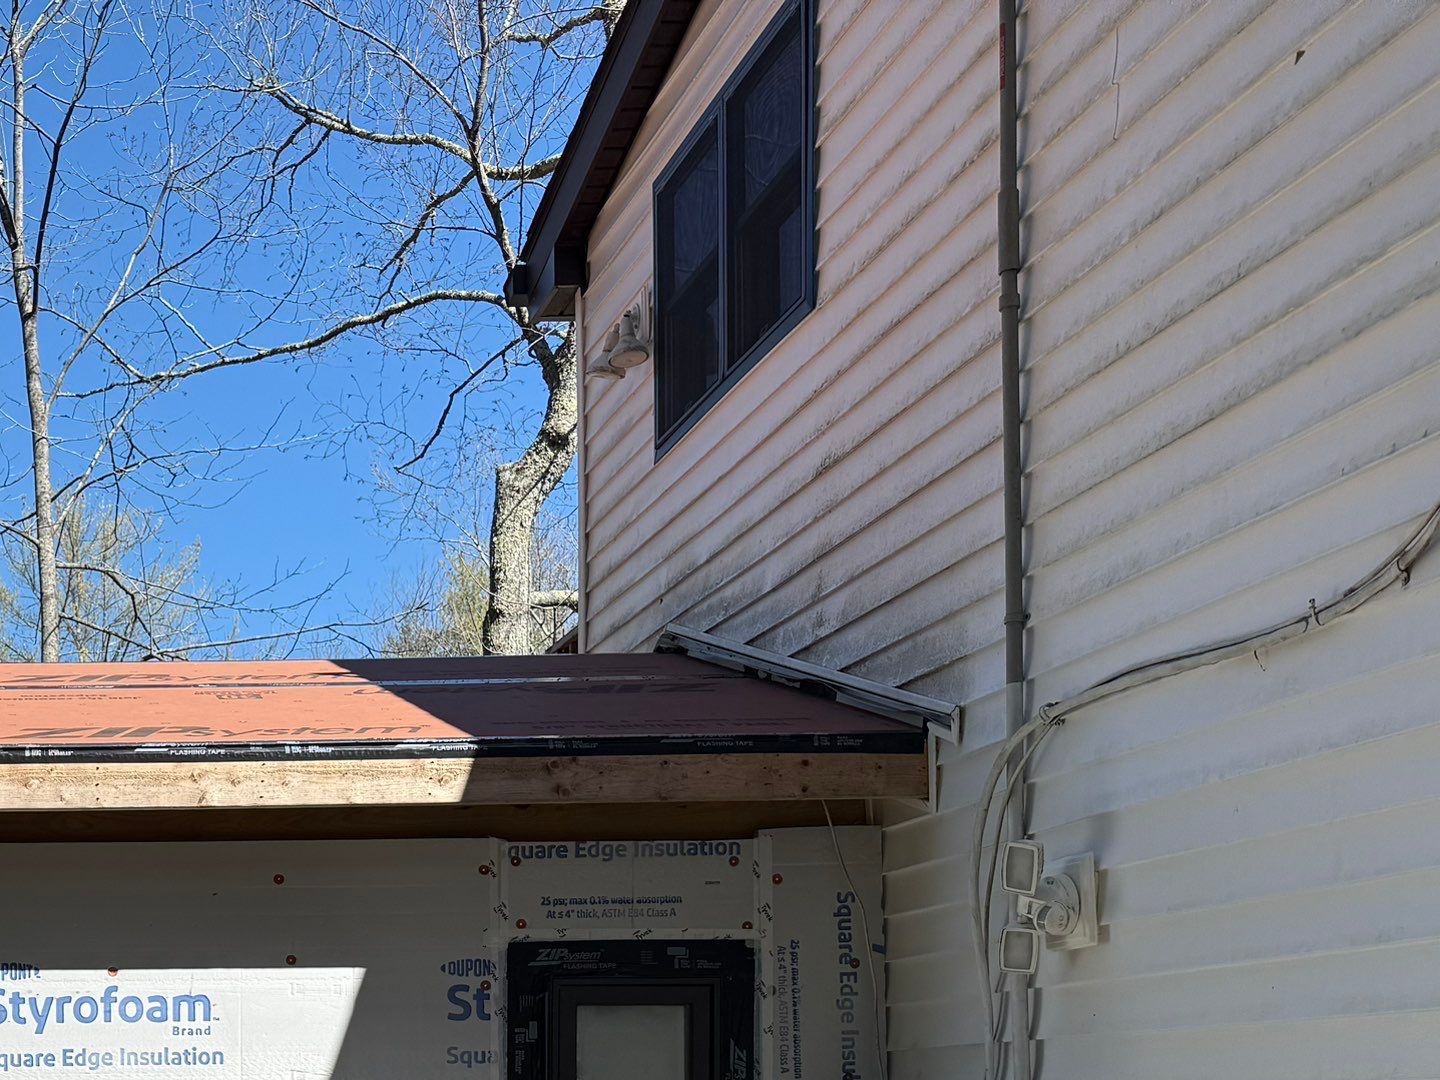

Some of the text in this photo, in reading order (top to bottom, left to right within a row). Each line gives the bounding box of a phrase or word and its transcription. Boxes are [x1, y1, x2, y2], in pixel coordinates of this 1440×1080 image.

[0, 673, 170, 683] ZIP
[507, 840, 741, 861] quare Edge Insulation
[541, 896, 553, 905] 25
[590, 895, 609, 905] 0.1%
[610, 896, 634, 904] water
[636, 895, 682, 906] absorption
[546, 910, 556, 919] At
[576, 909, 600, 919] thick,
[601, 909, 625, 918] ASTM
[628, 909, 644, 917] E84
[646, 908, 668, 917] Class
[669, 908, 677, 917] A
[833, 890, 857, 965] Square
[536, 949, 568, 961] ZIP
[447, 959, 494, 977] DUPON
[835, 971, 859, 1024] Edge
[172, 1025, 211, 1036] Brand
[61, 1048, 113, 1070] Edge
[120, 1047, 224, 1066] Insulation
